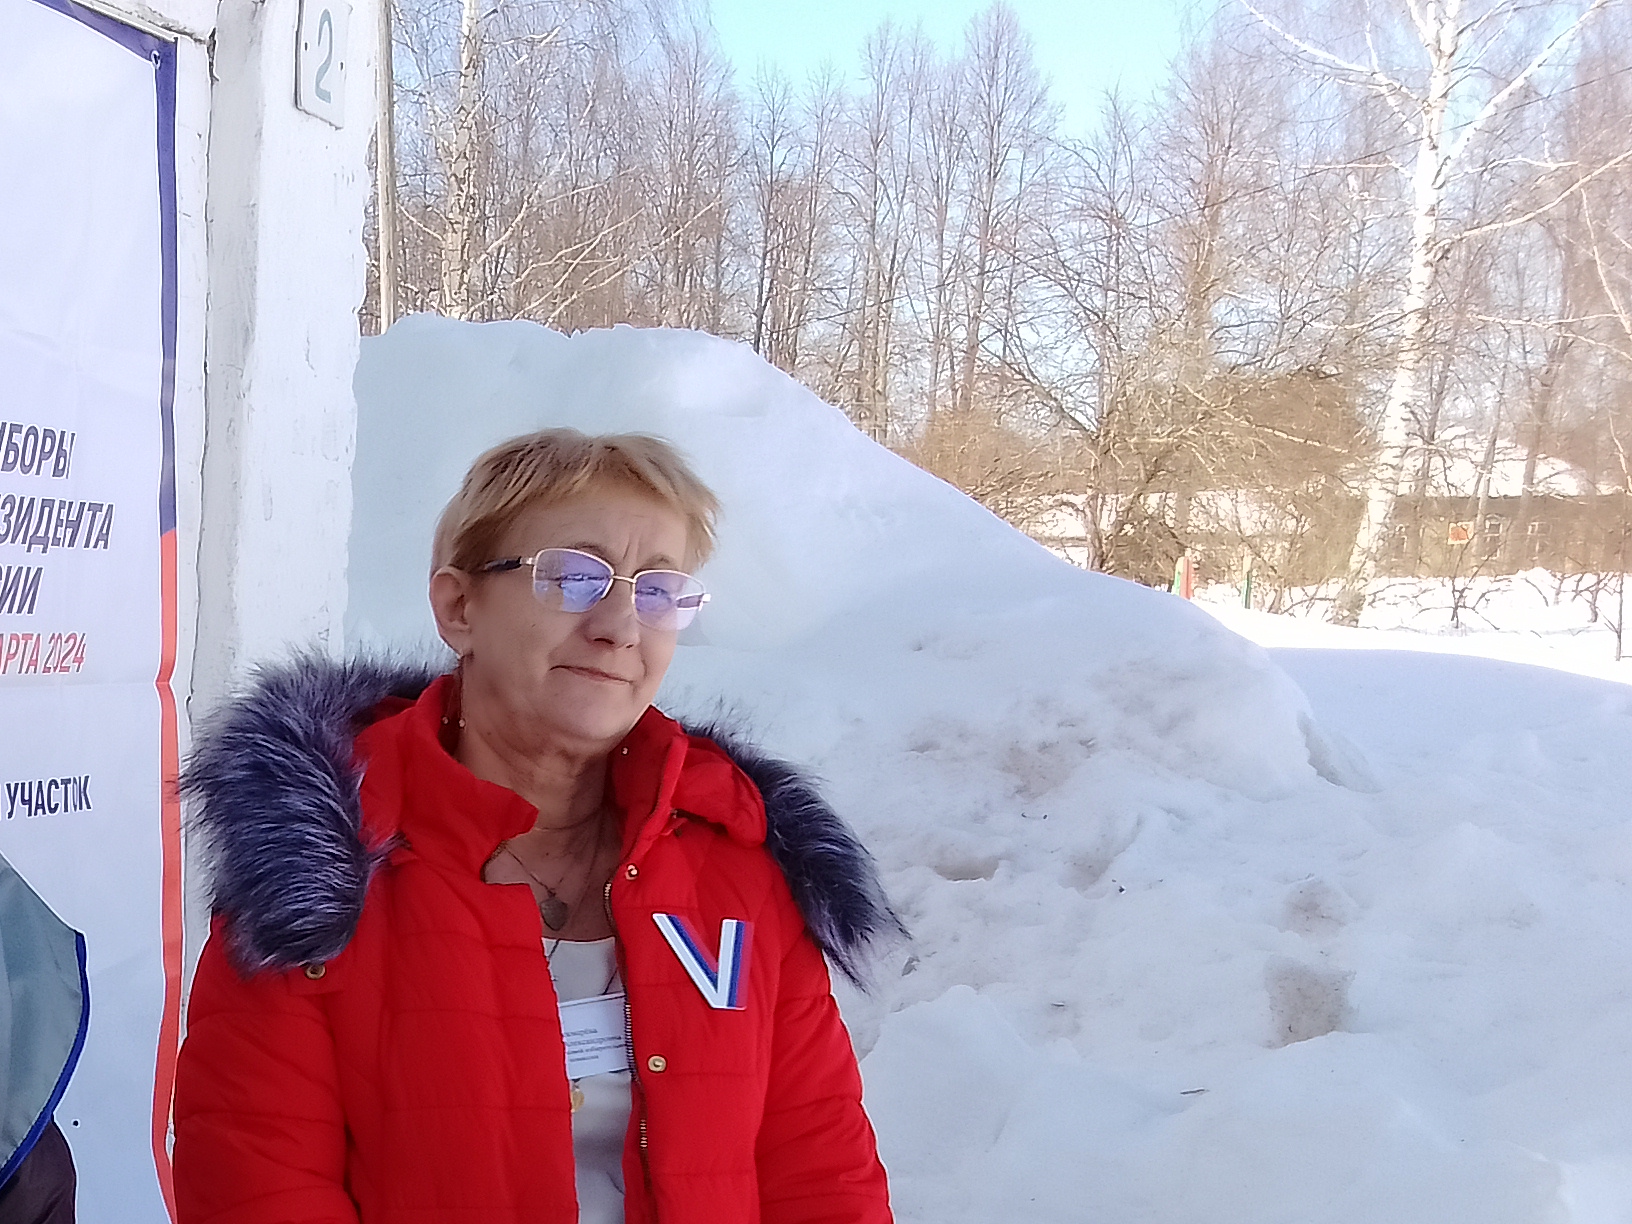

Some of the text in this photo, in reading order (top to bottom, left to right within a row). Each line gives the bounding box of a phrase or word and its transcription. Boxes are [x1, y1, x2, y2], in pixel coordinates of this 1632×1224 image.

[315, 8, 334, 103] 2
[41, 632, 86, 674] 2024
[5, 775, 92, 820] УЧАСТОК
